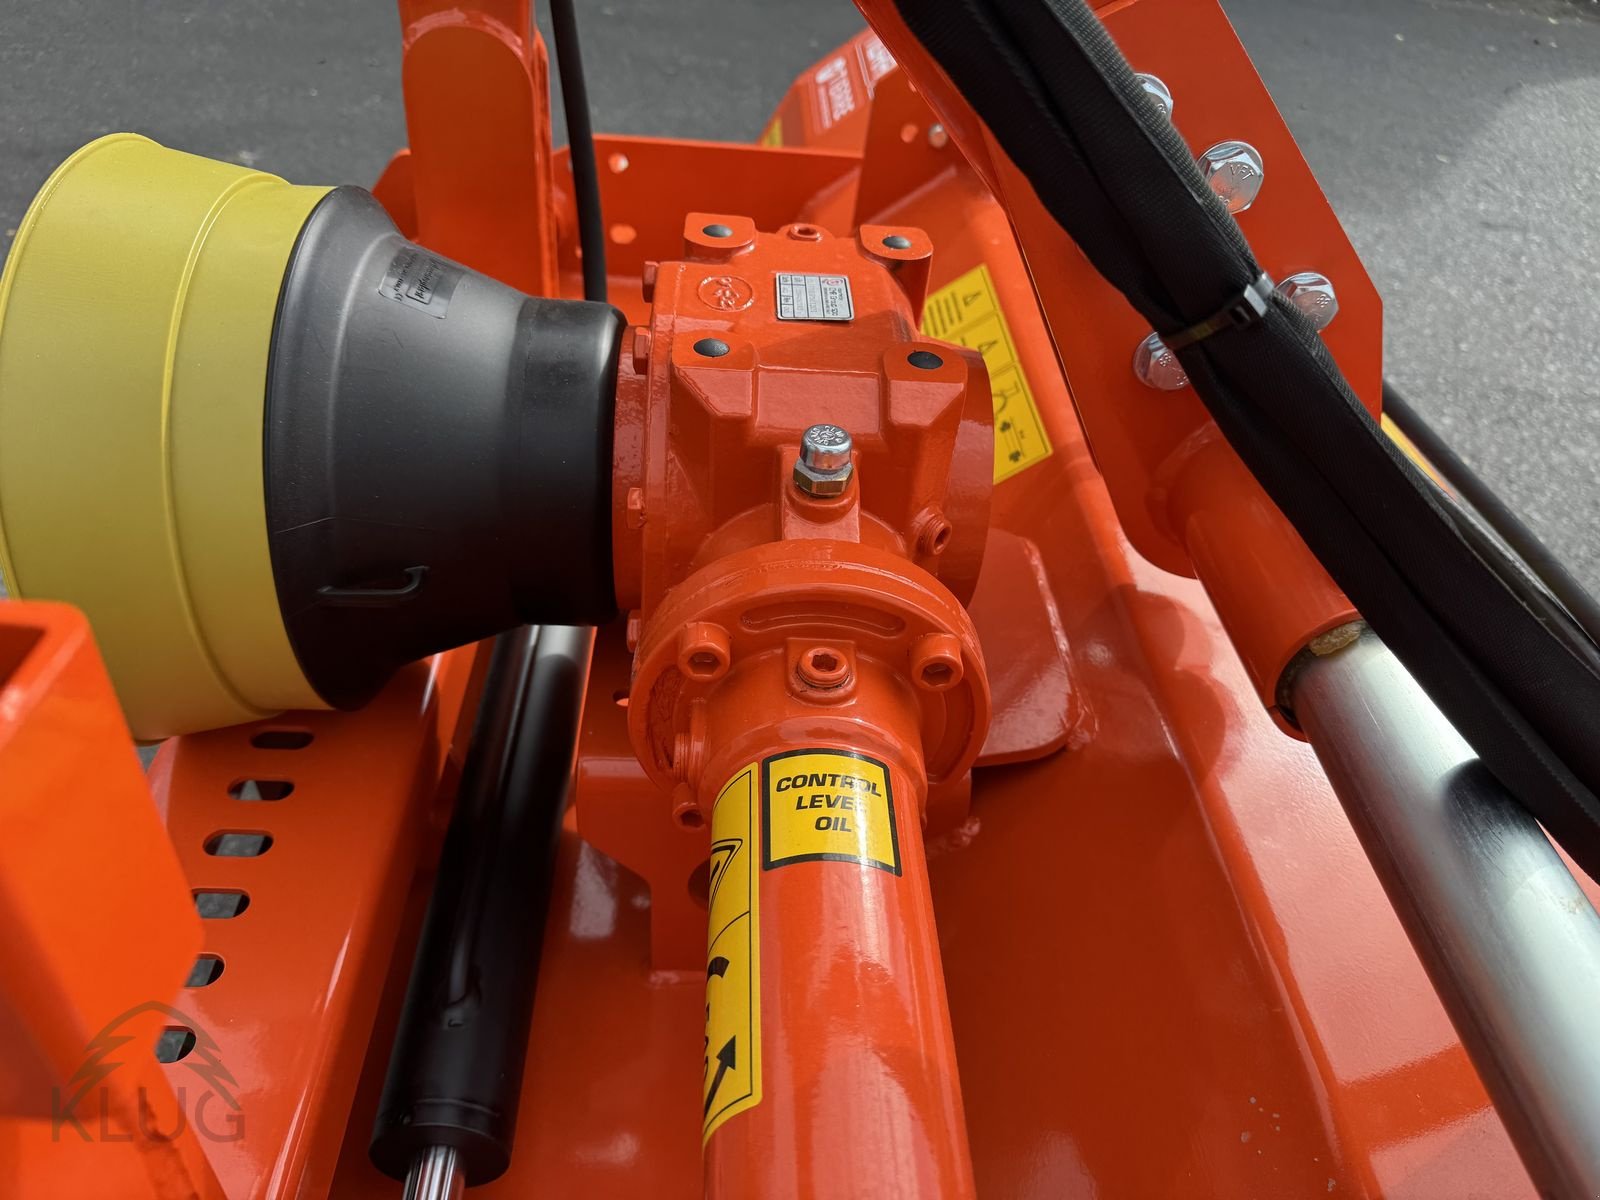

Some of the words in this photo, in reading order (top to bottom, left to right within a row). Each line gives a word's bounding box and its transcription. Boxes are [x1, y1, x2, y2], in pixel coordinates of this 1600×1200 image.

[1229, 164, 1255, 180] VFT
[776, 773, 882, 798] CONTROL
[814, 816, 852, 832] OIL
